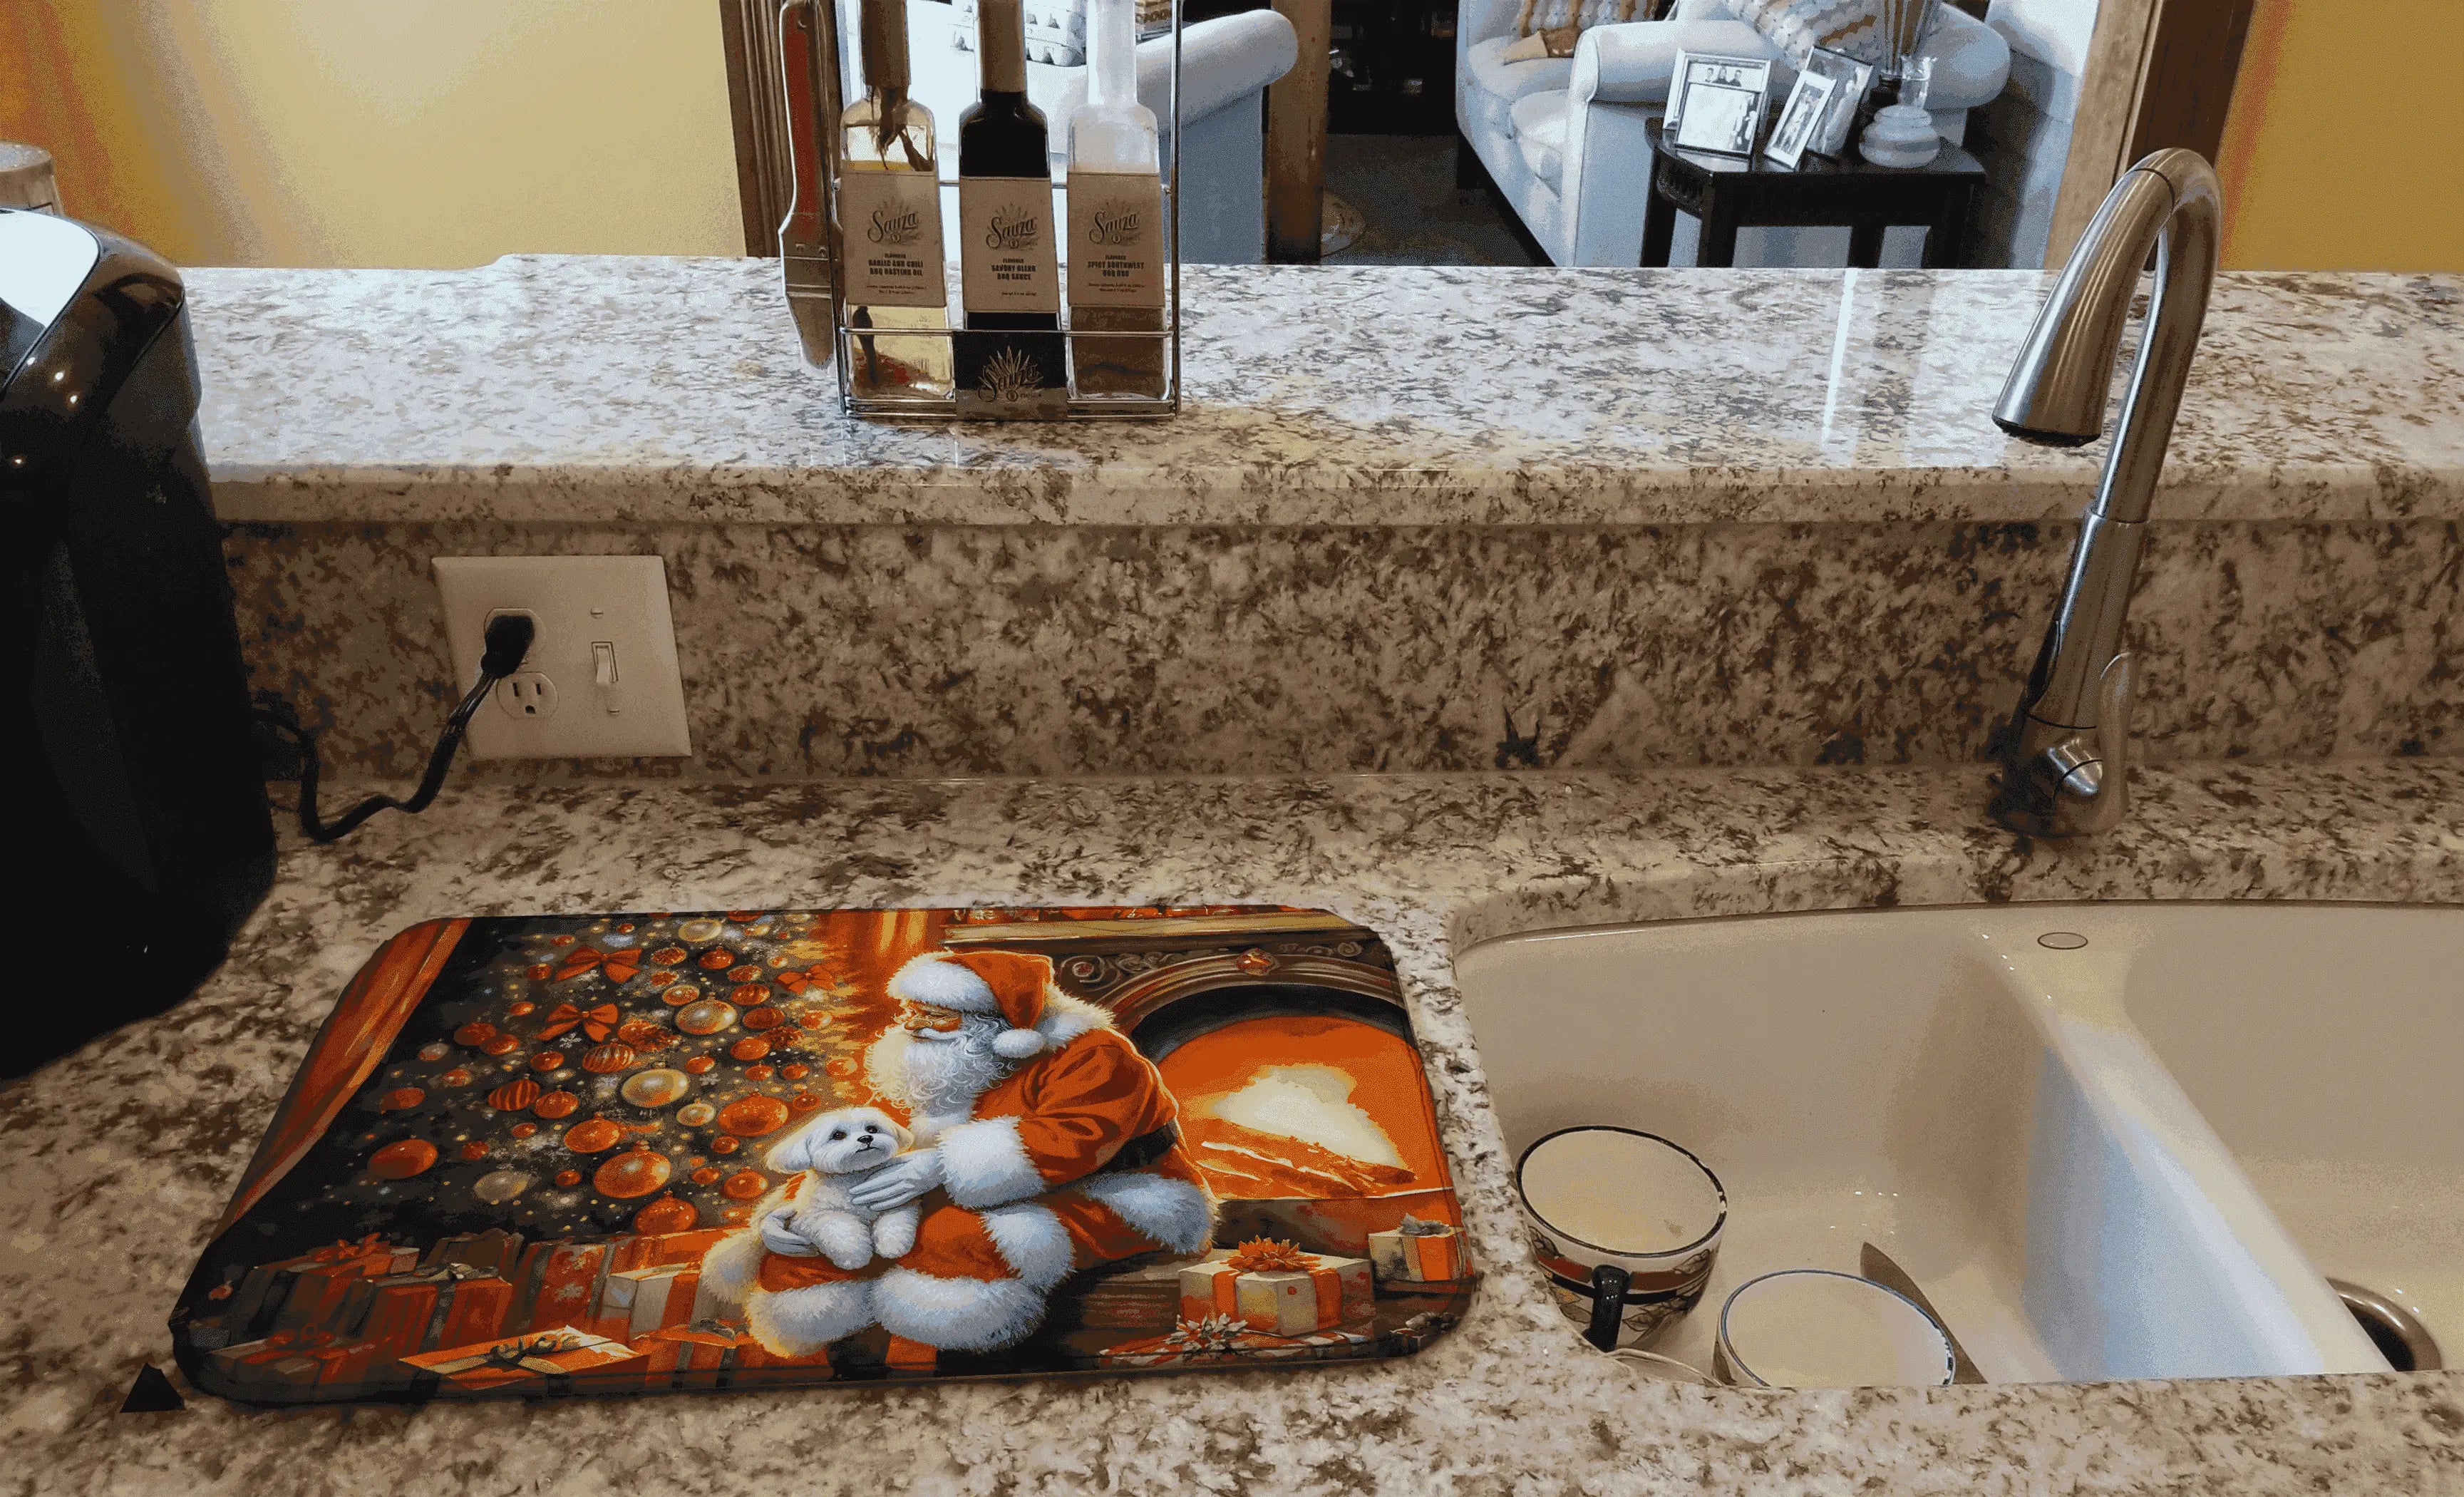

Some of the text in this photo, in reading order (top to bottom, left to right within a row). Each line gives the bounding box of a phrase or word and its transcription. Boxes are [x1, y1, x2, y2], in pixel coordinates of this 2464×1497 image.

[867, 210, 918, 242] Sauza
[986, 216, 1038, 249] Sauza
[1088, 211, 1140, 244] Sauza
